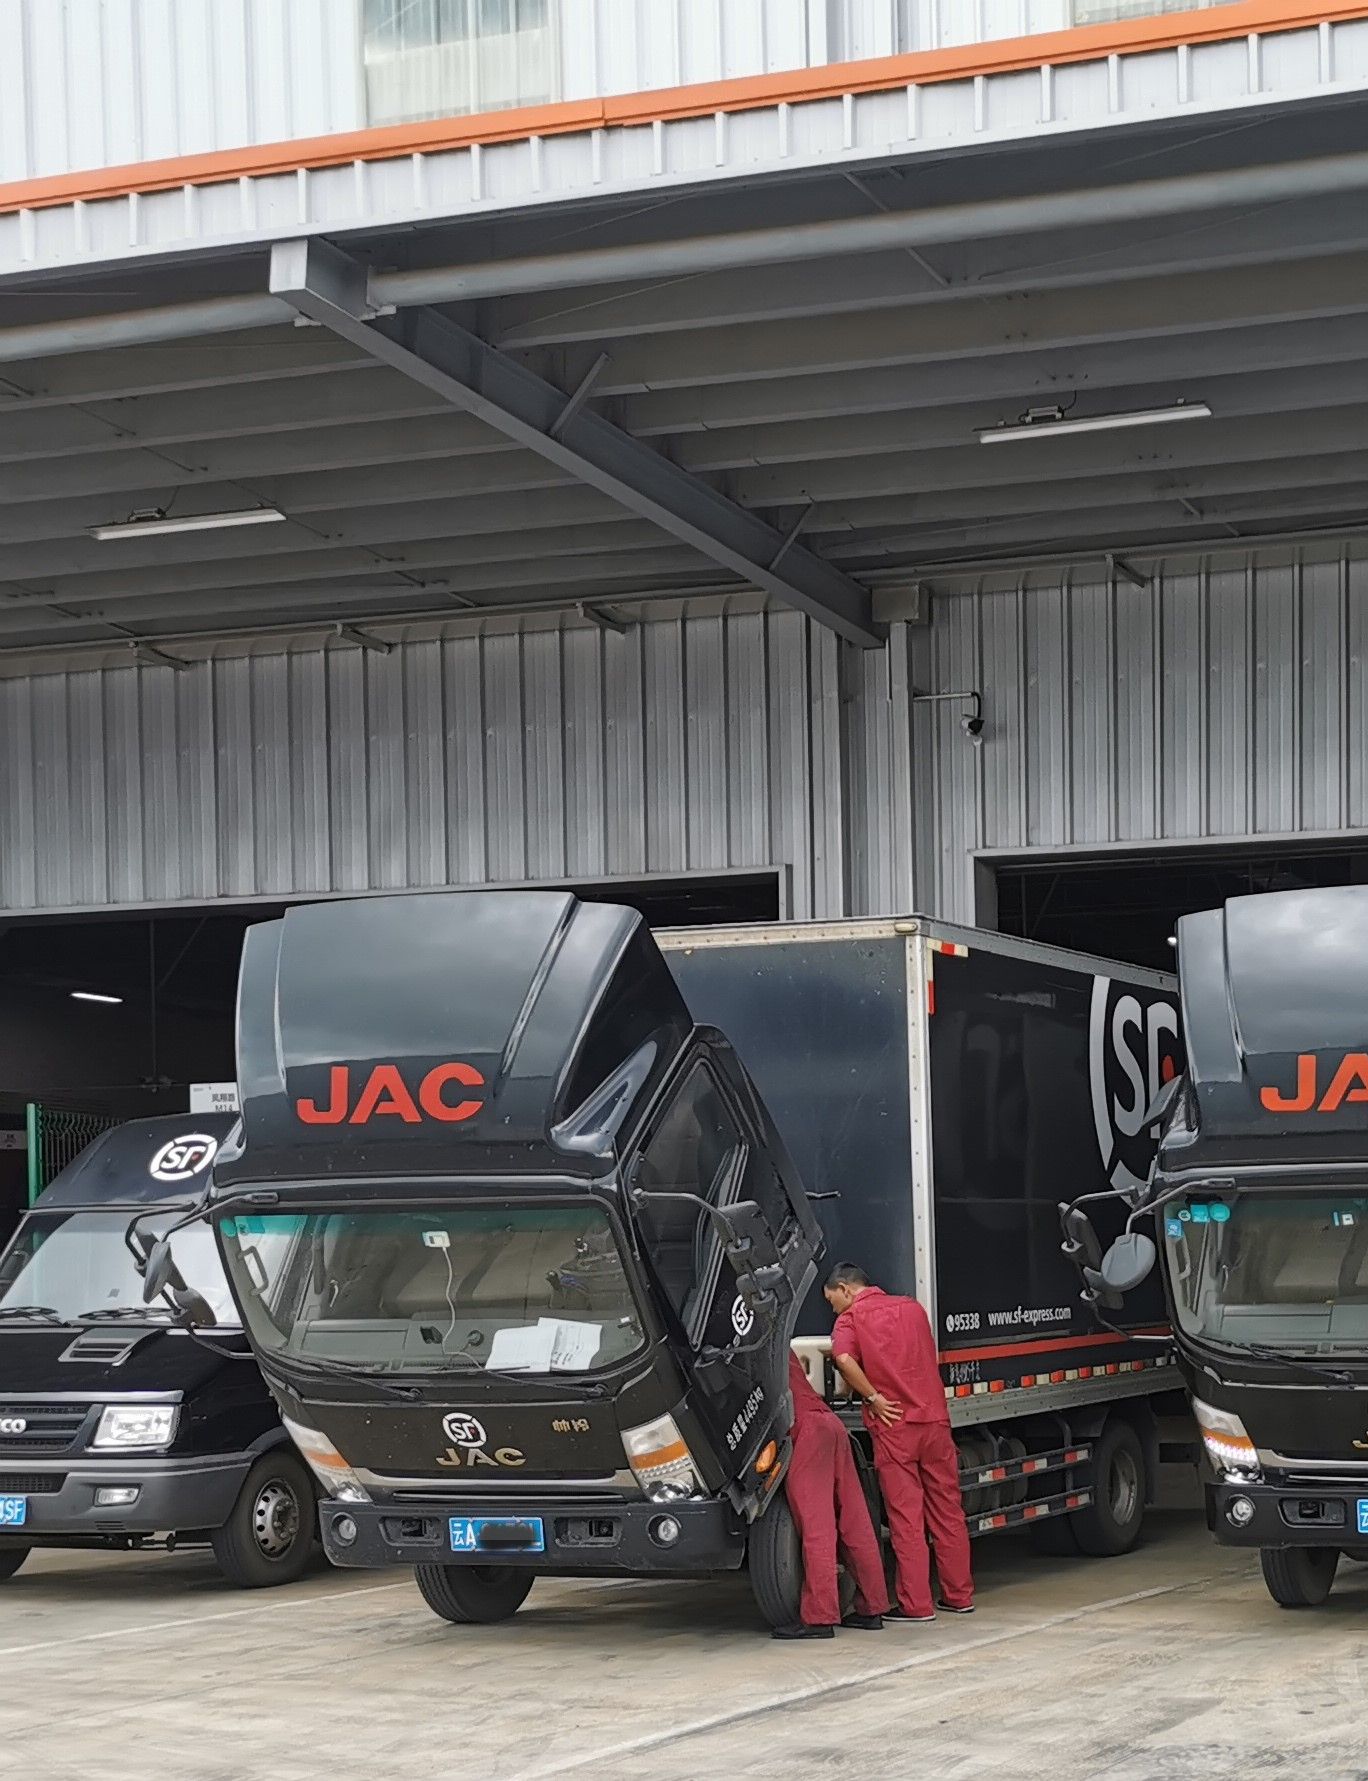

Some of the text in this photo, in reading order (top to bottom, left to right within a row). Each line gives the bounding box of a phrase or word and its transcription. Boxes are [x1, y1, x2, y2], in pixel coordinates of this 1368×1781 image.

[297, 1062, 484, 1124] JAC
[955, 1306, 1072, 1331] 95338 www.sf-express.com
[436, 1448, 527, 1467] JAC
